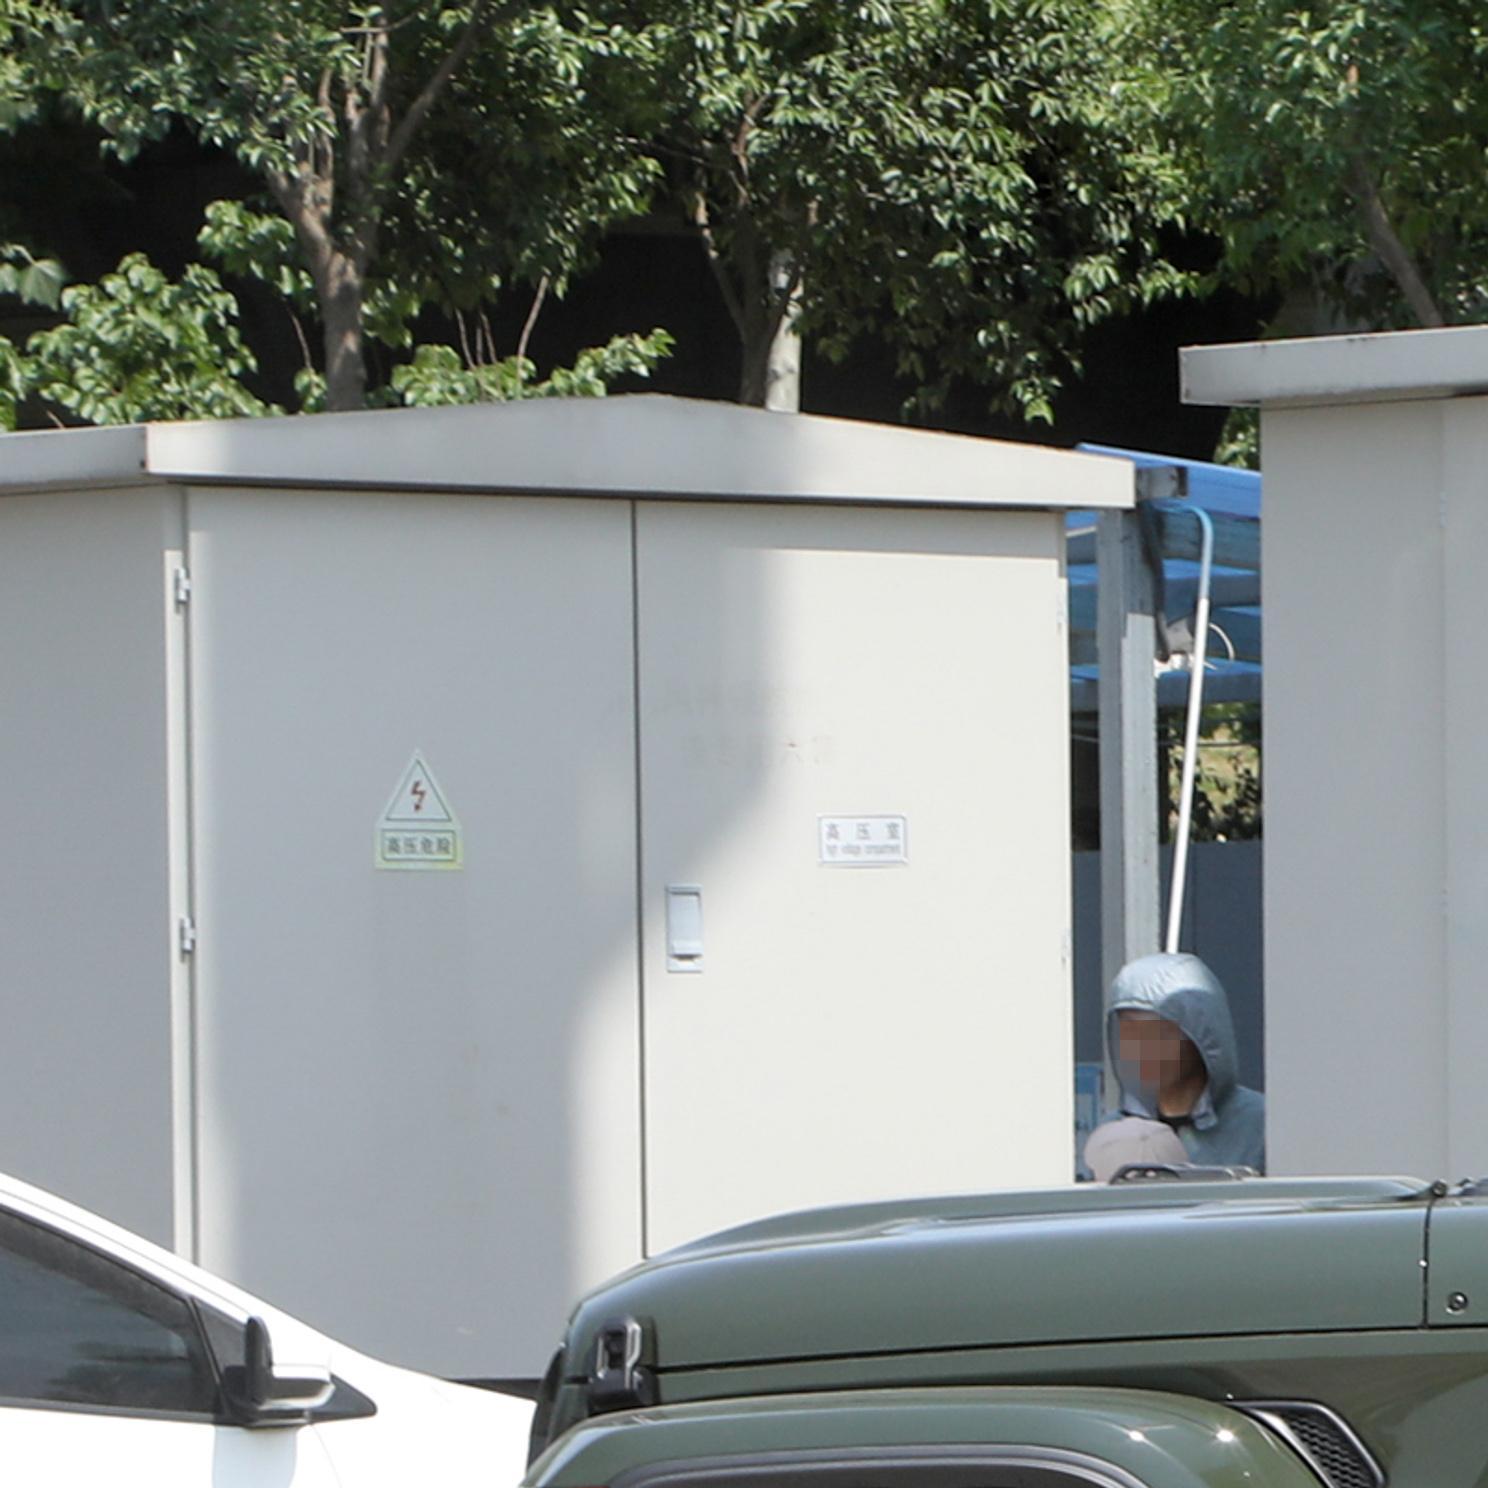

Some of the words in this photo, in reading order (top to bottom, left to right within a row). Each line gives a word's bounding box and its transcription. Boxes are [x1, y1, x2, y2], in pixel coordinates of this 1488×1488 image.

[825, 822, 900, 841] 高压室
[386, 836, 451, 855] 高压危险
